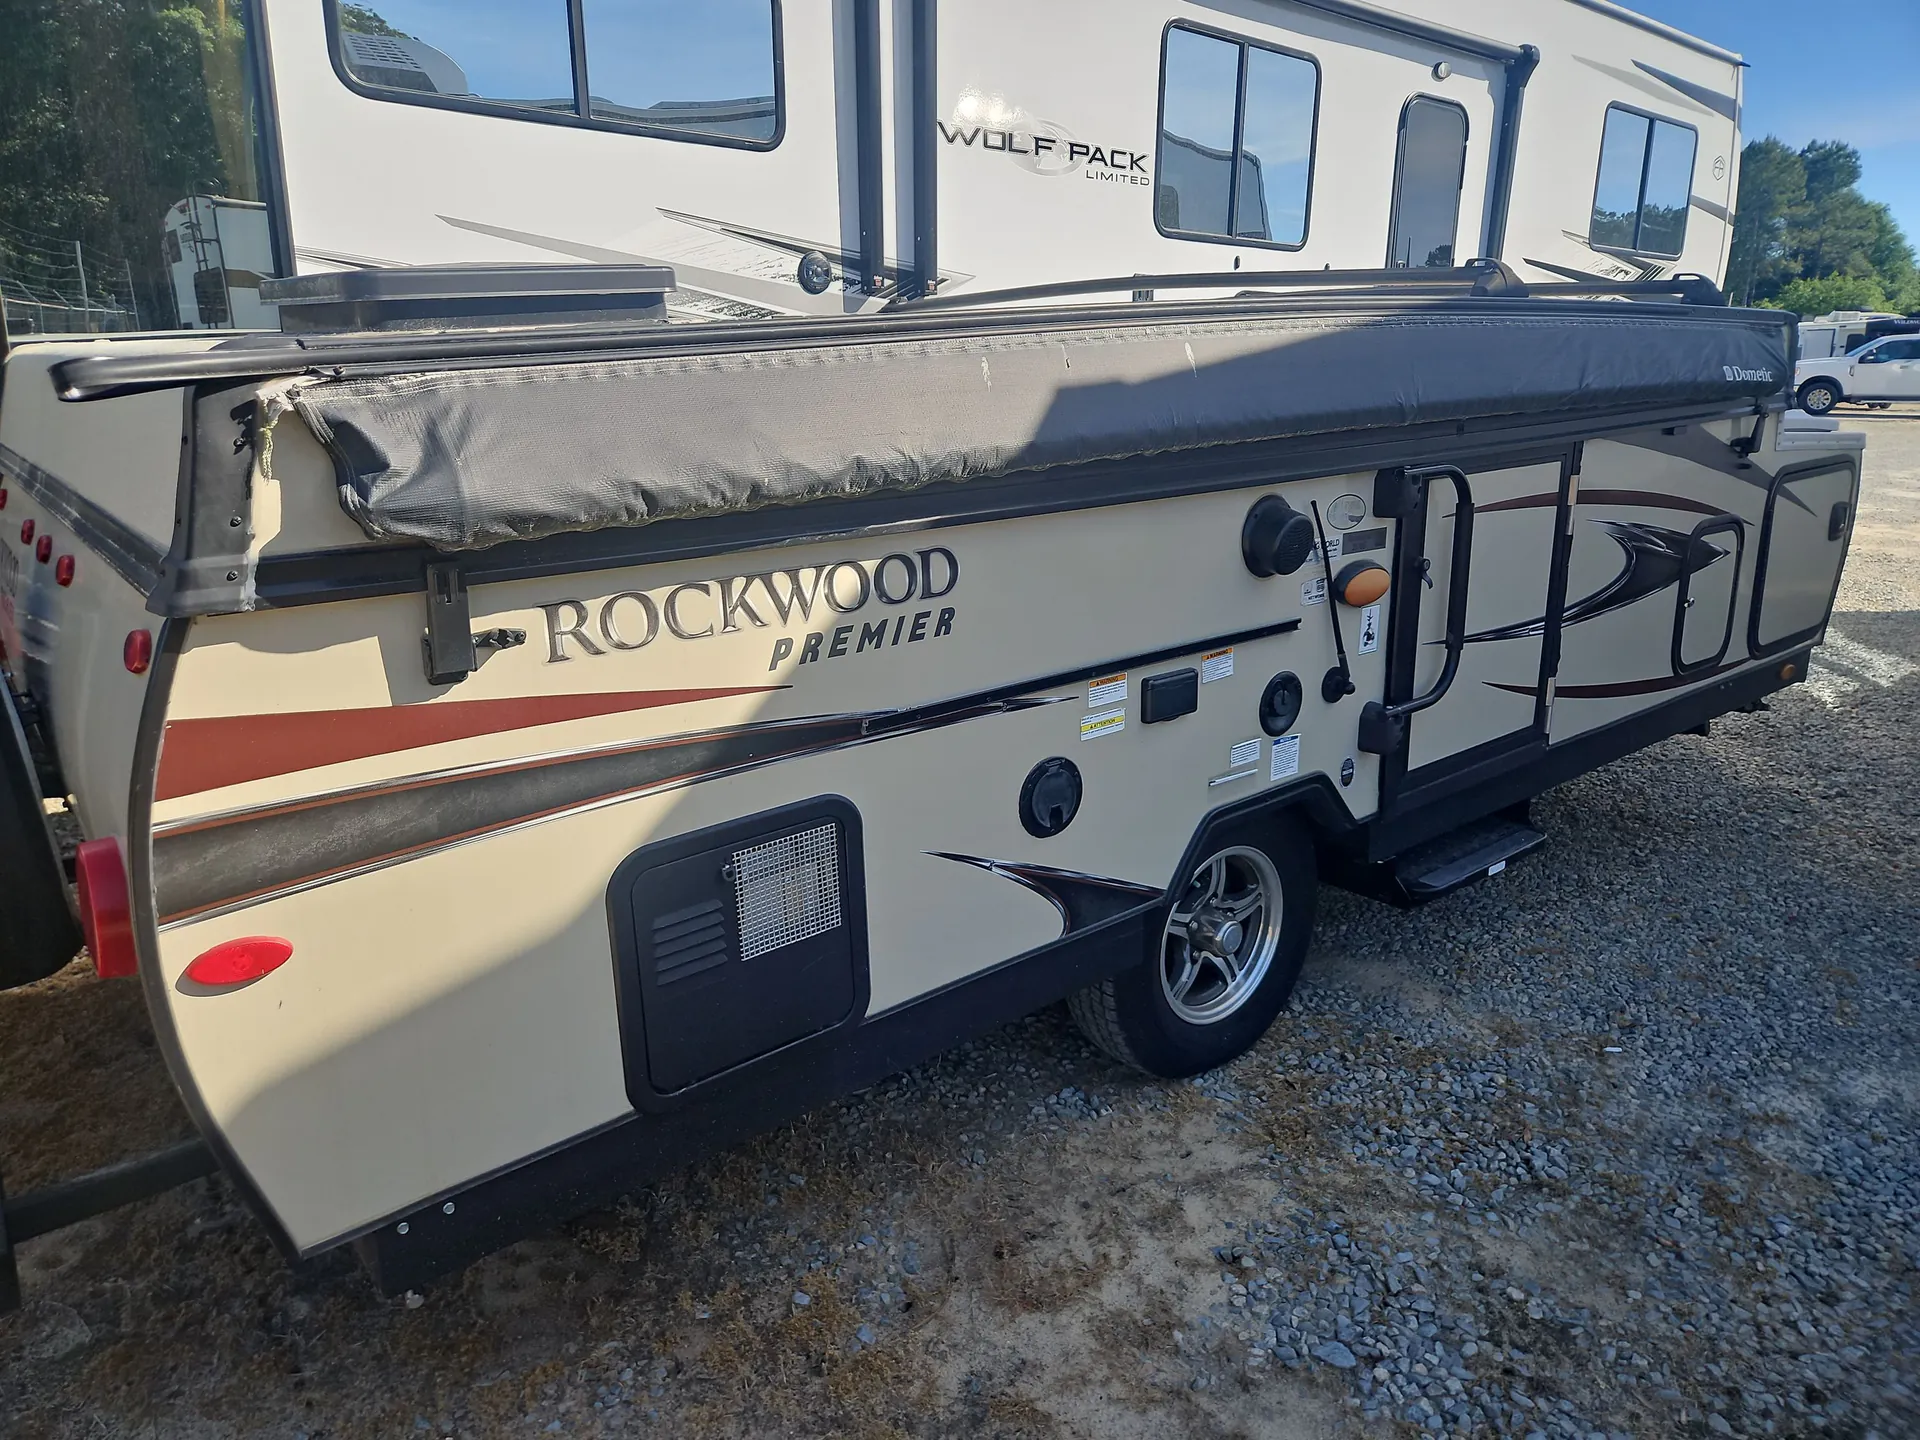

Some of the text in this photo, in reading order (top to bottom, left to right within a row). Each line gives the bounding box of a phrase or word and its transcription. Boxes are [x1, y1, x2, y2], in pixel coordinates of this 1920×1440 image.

[937, 120, 1150, 173] WOLF PACK
[1086, 169, 1150, 186] LIMITED
[1732, 365, 1773, 382] Dometic
[537, 546, 960, 663] ROCKWOOD
[768, 606, 957, 671] PREMIER
